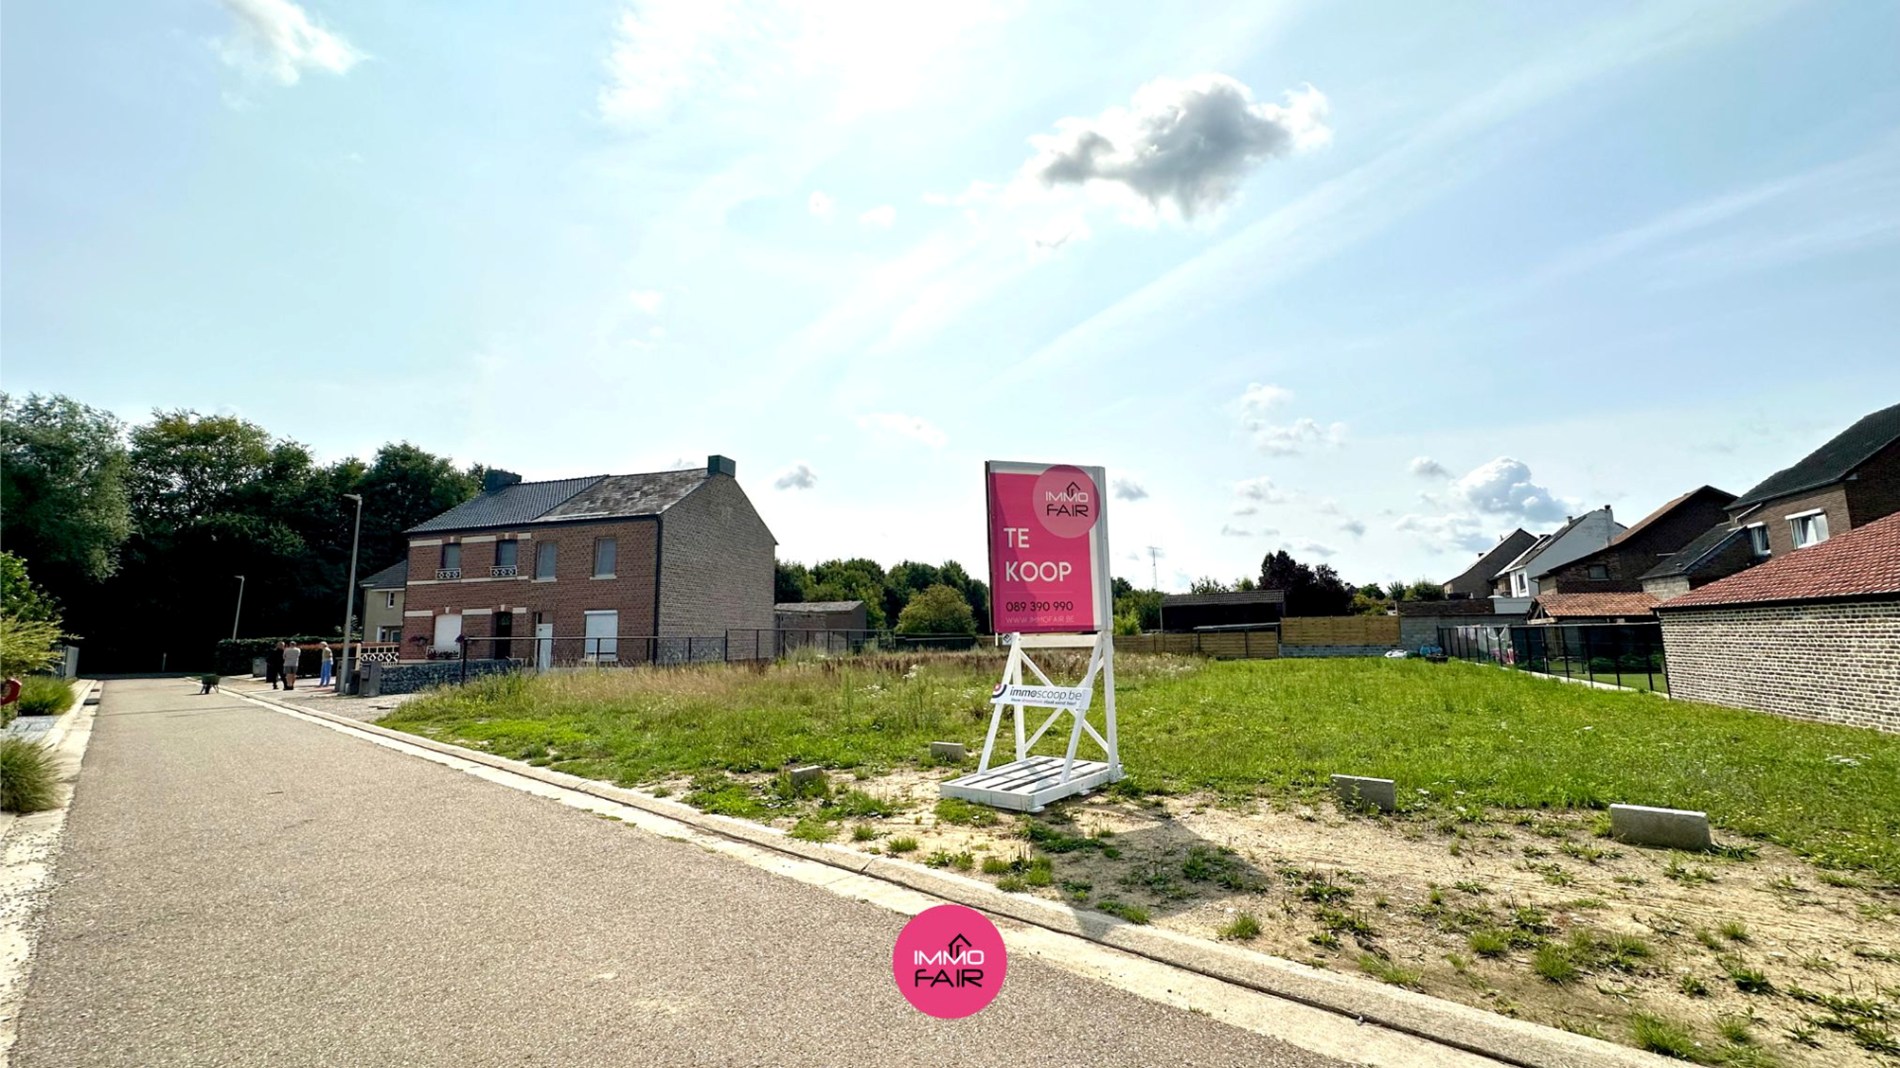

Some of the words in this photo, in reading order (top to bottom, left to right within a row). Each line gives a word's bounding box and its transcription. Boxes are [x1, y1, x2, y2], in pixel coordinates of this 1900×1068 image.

[1045, 491, 1089, 503] IMMO
[1046, 503, 1089, 517] FAIR
[1003, 527, 1030, 548] TE
[1005, 561, 1072, 582] KOOP
[1005, 601, 1027, 612] 089
[1030, 601, 1050, 612] 390
[1053, 601, 1074, 611] 990
[1009, 686, 1082, 700] immoscoop.be
